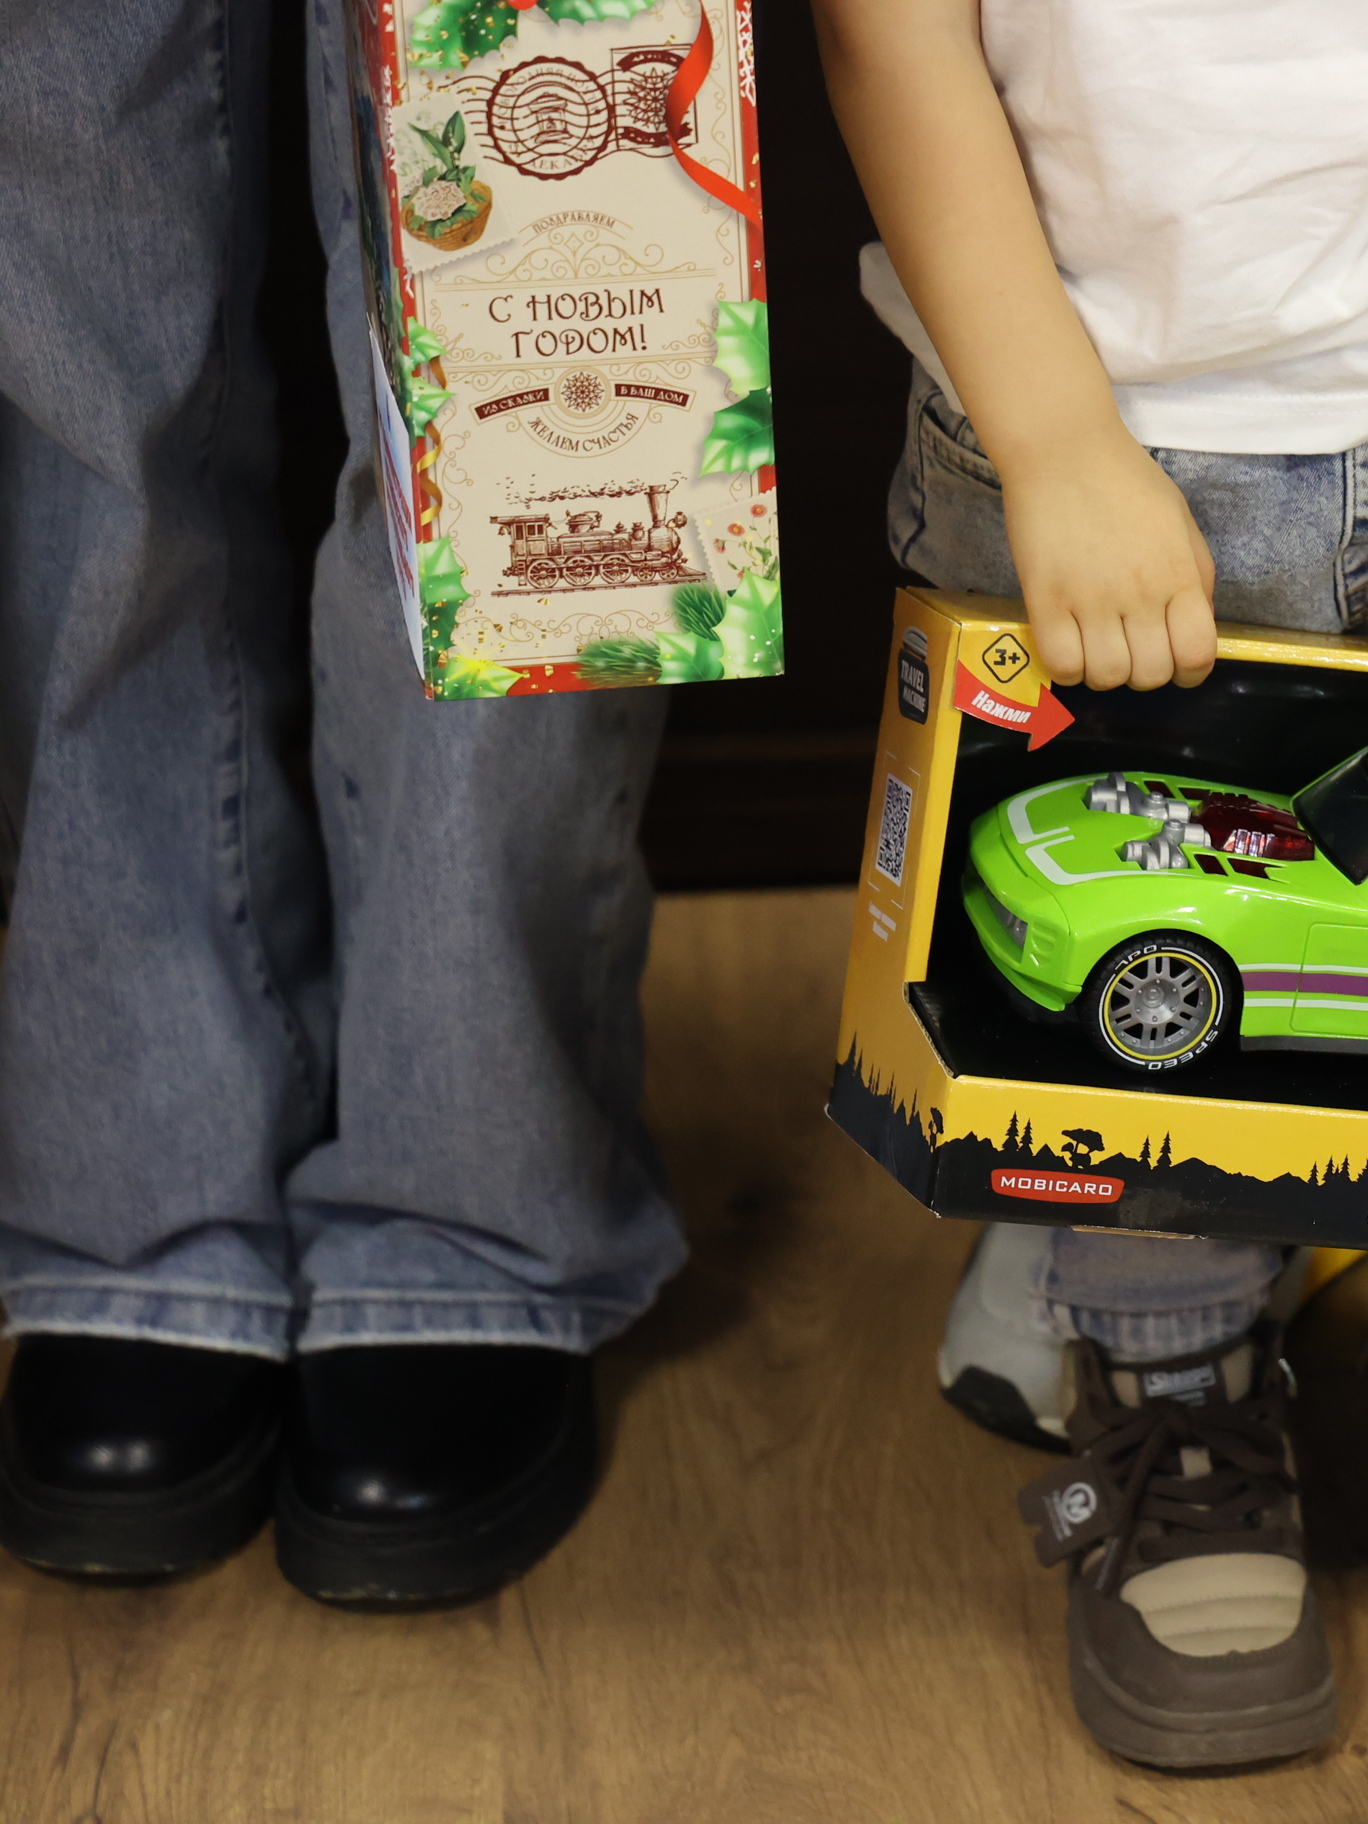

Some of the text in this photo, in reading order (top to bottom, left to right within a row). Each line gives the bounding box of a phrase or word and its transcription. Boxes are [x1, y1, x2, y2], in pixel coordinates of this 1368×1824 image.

[532, 212, 616, 235] ПОЗДРАВЛЯЕМ
[489, 288, 664, 323] С НОВЫМ
[511, 324, 647, 358] ГОДОМ!
[482, 390, 545, 416] ИЗ СКАЗКИ
[620, 386, 684, 404] В ВАШ ДОМ
[528, 412, 639, 452] ЖЕЛАЕМ СЧАСТЬЯ
[993, 648, 1020, 666] 3+
[901, 659, 924, 693] TRAVEL
[903, 686, 926, 713] MACHINE
[971, 690, 1032, 723] Нажми
[1000, 1175, 1113, 1196] MOBICARO
